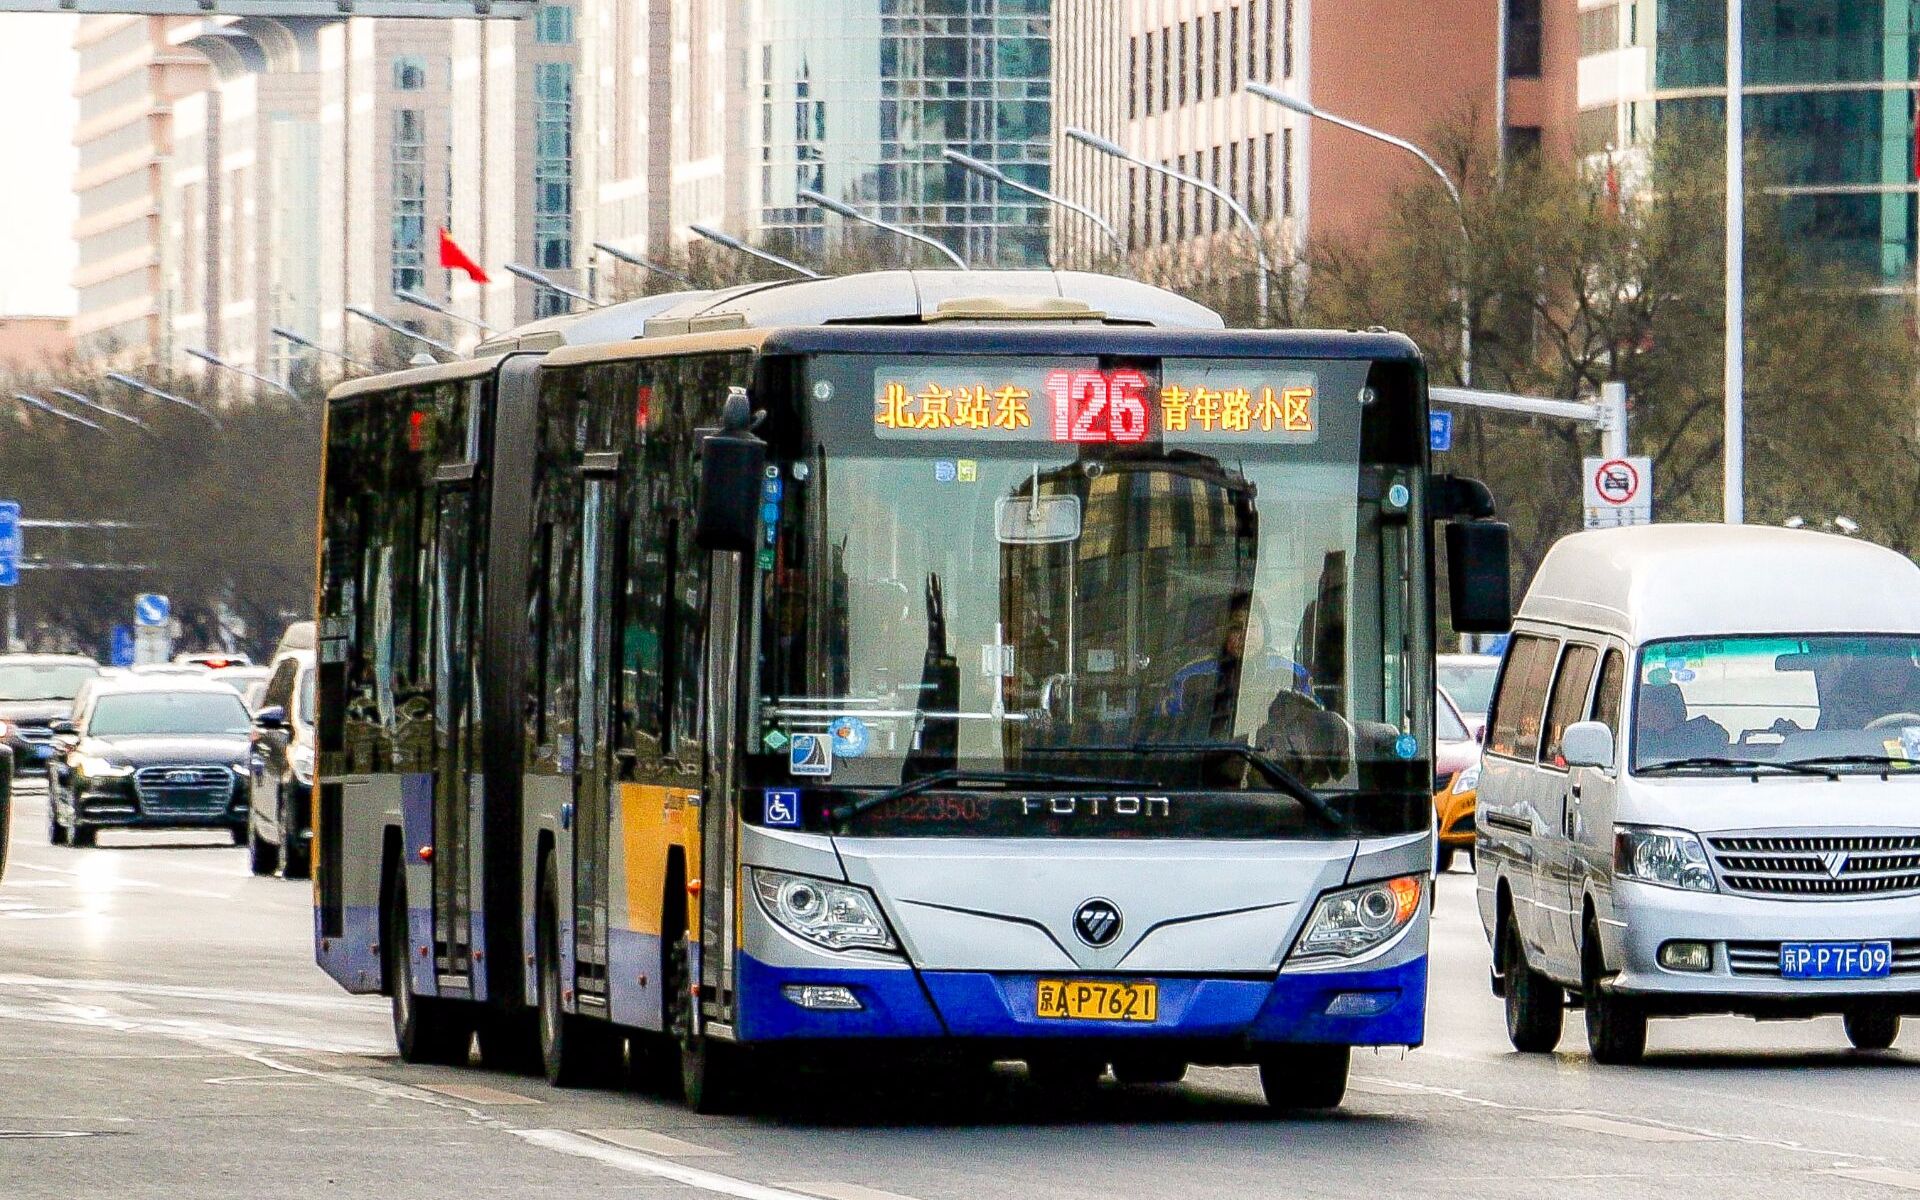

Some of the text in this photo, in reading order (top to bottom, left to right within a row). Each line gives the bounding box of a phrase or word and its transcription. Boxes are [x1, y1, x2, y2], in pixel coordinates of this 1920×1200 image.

[876, 371, 1314, 443] 北京站东 126 青年路小区
[1021, 796, 1169, 816] FOTON
